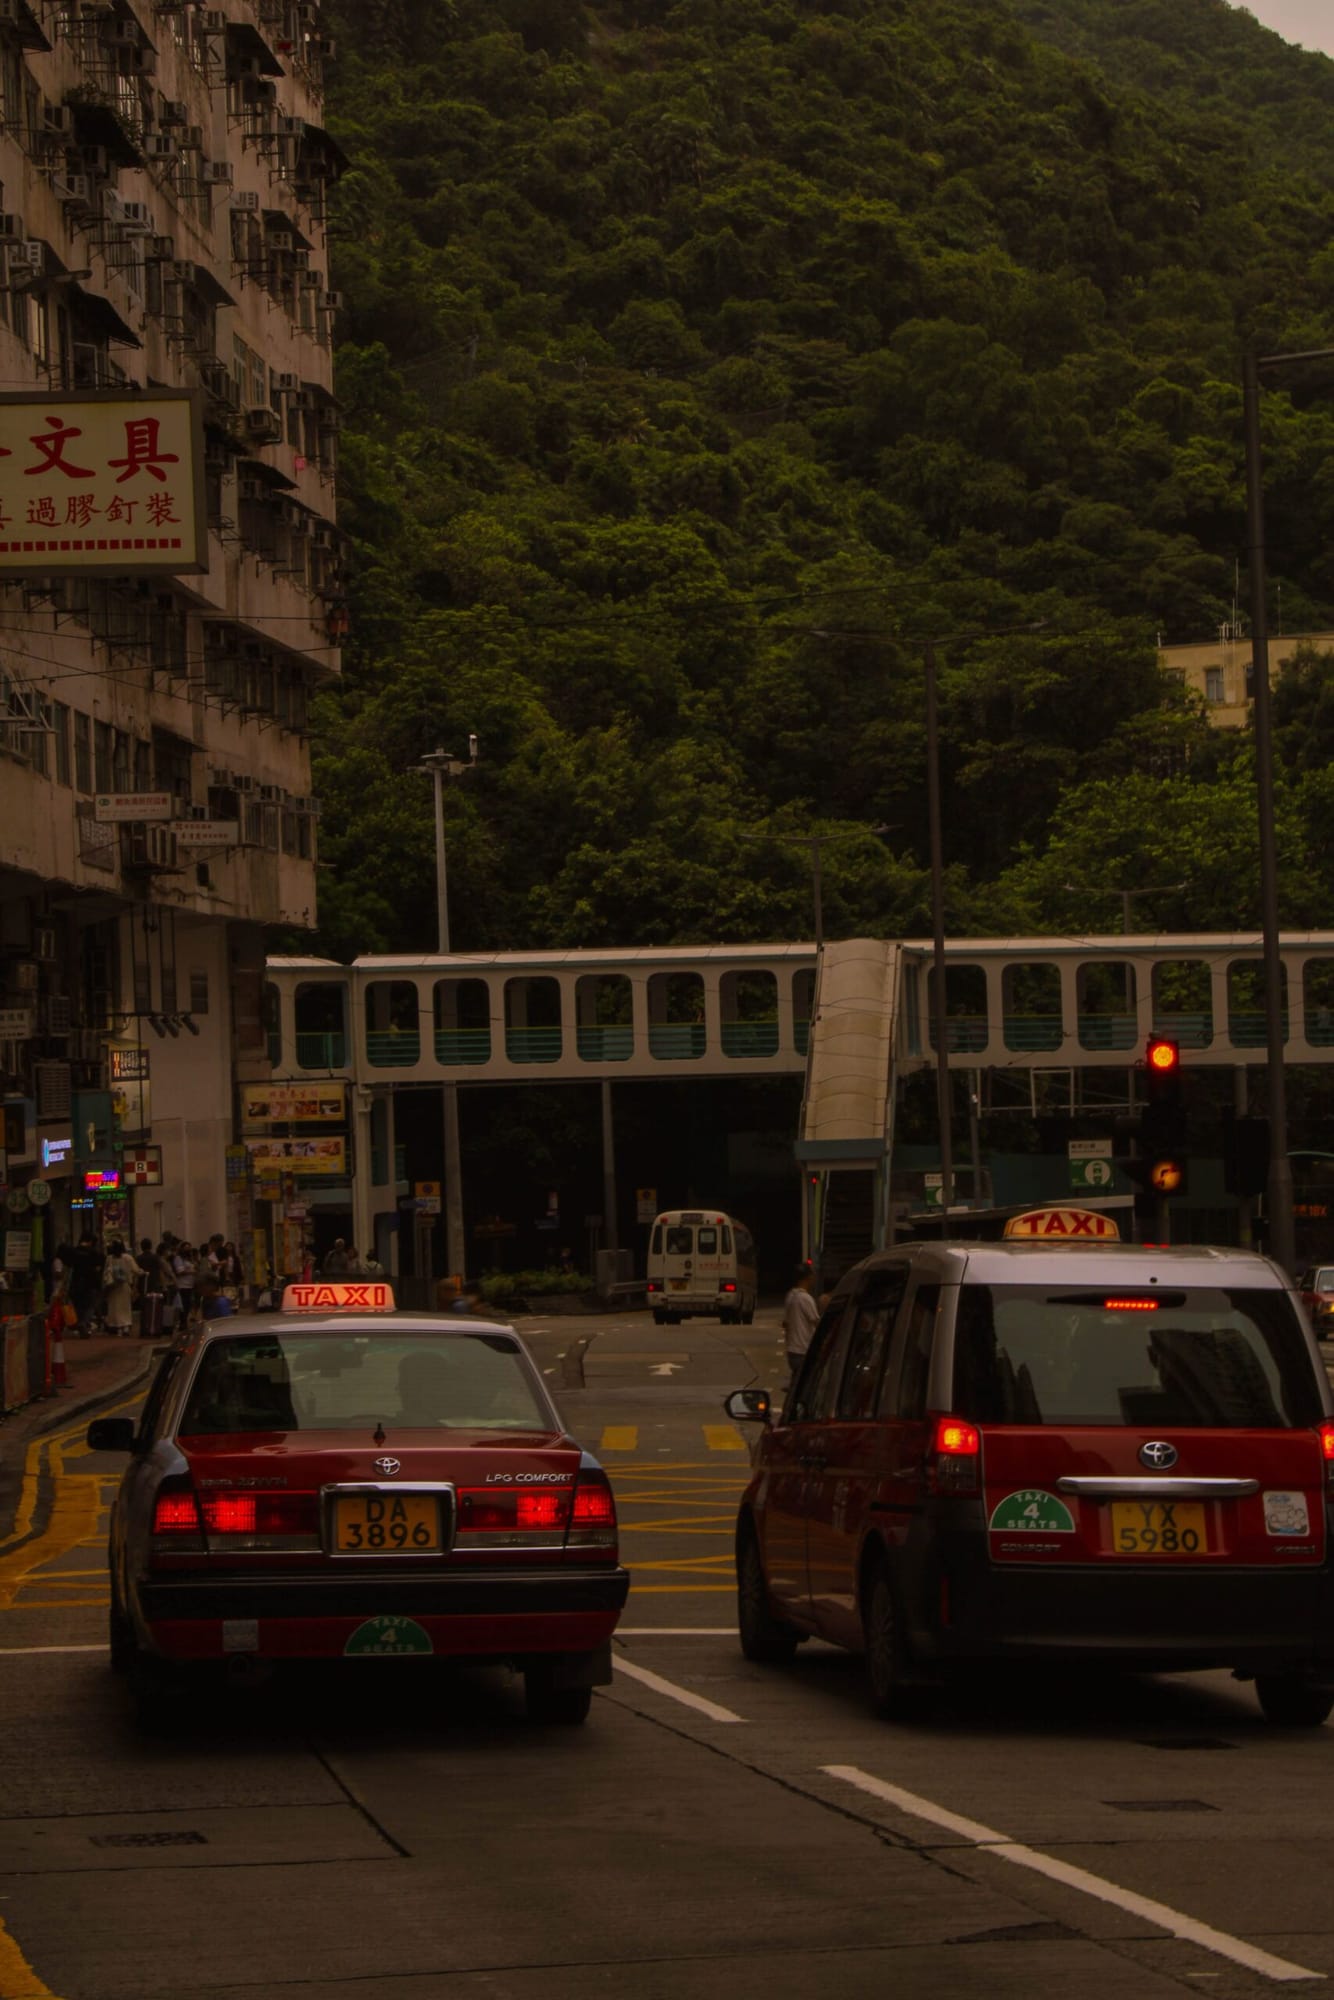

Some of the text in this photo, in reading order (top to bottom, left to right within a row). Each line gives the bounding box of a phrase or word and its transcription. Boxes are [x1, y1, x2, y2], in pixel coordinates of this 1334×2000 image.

[0, 416, 180, 483] 文具
[1022, 1212, 1105, 1236] TAXI
[291, 1286, 386, 1307] TAXI
[485, 1472, 574, 1483] LPG COMFORT
[1014, 1491, 1049, 1504] TAXI
[366, 1498, 407, 1522] DA
[1023, 1503, 1040, 1519] 4
[1140, 1503, 1177, 1529] YX
[346, 1522, 431, 1547] 3896
[1007, 1520, 1058, 1529] SEATS
[1119, 1528, 1199, 1552] 5980
[380, 1628, 397, 1643] 4
